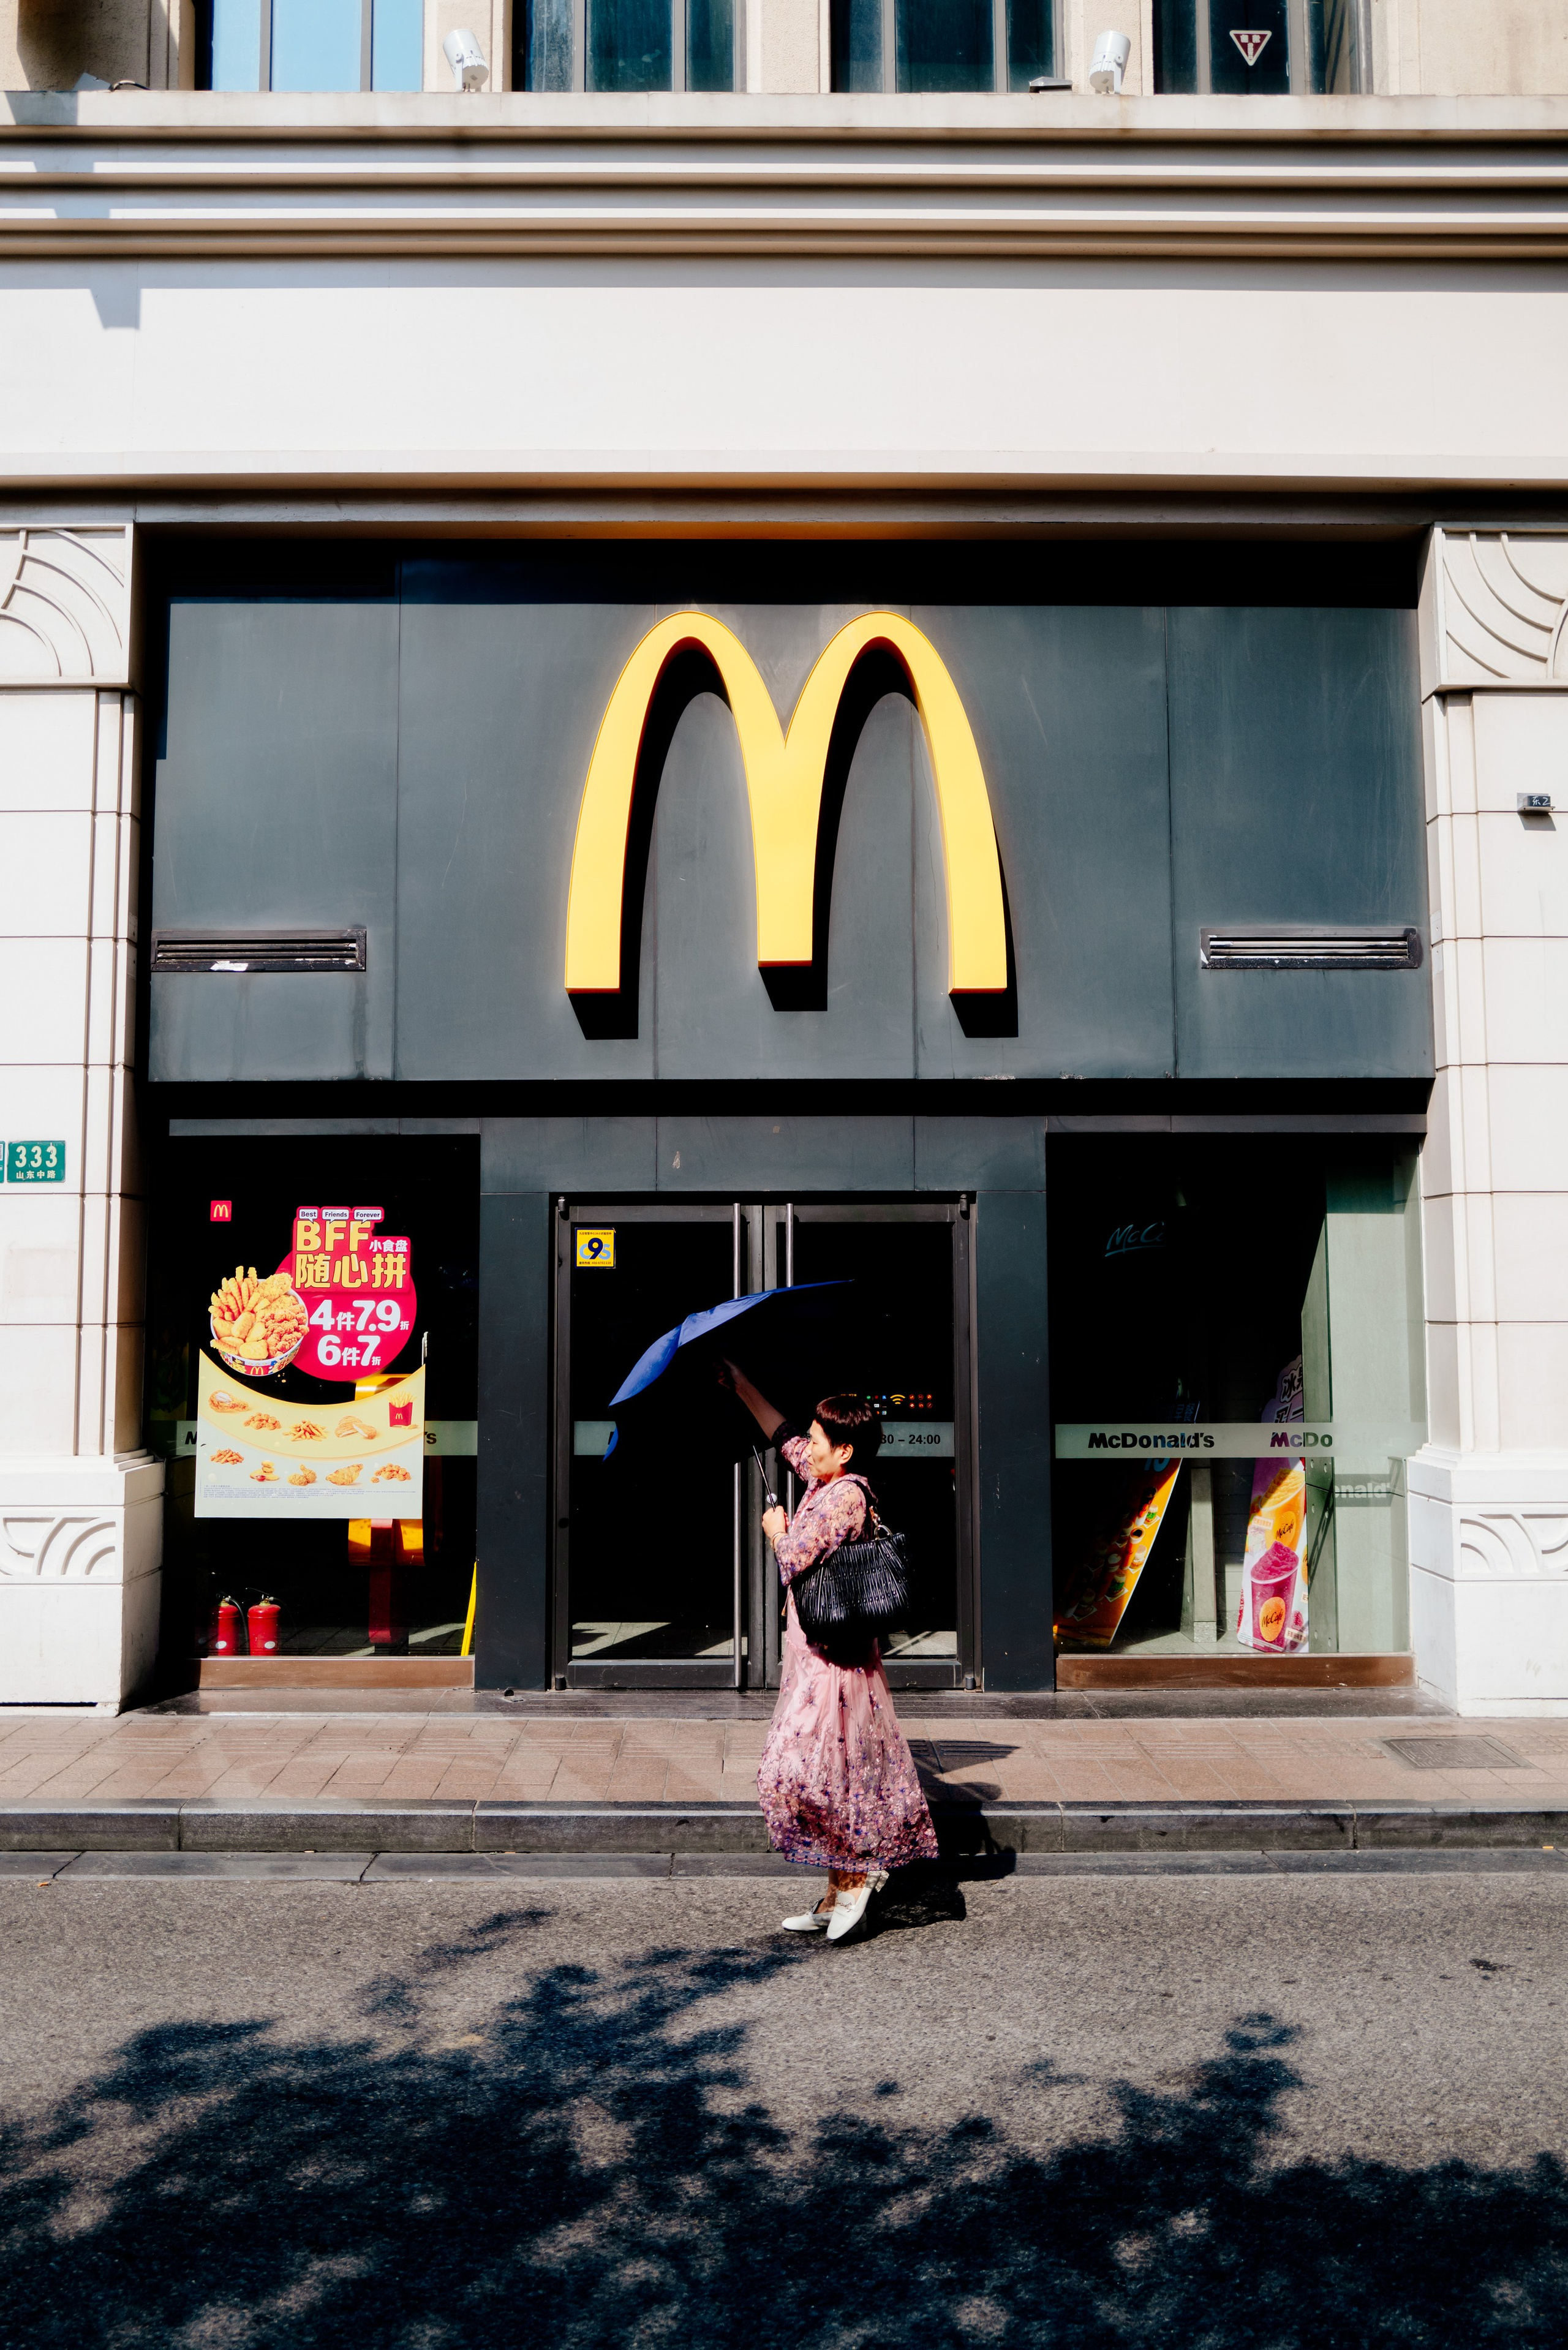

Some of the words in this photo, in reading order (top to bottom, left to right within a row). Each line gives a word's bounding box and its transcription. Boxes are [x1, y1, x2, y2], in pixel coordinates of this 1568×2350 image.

[15, 1145, 58, 1168] 333
[16, 1170, 56, 1179] 山东中路
[296, 1220, 371, 1252] BFF
[369, 1239, 408, 1252] 小食盘
[295, 1253, 407, 1289] 随心拼
[908, 1434, 941, 1445] 24:00
[1088, 1432, 1215, 1448] McDonald's
